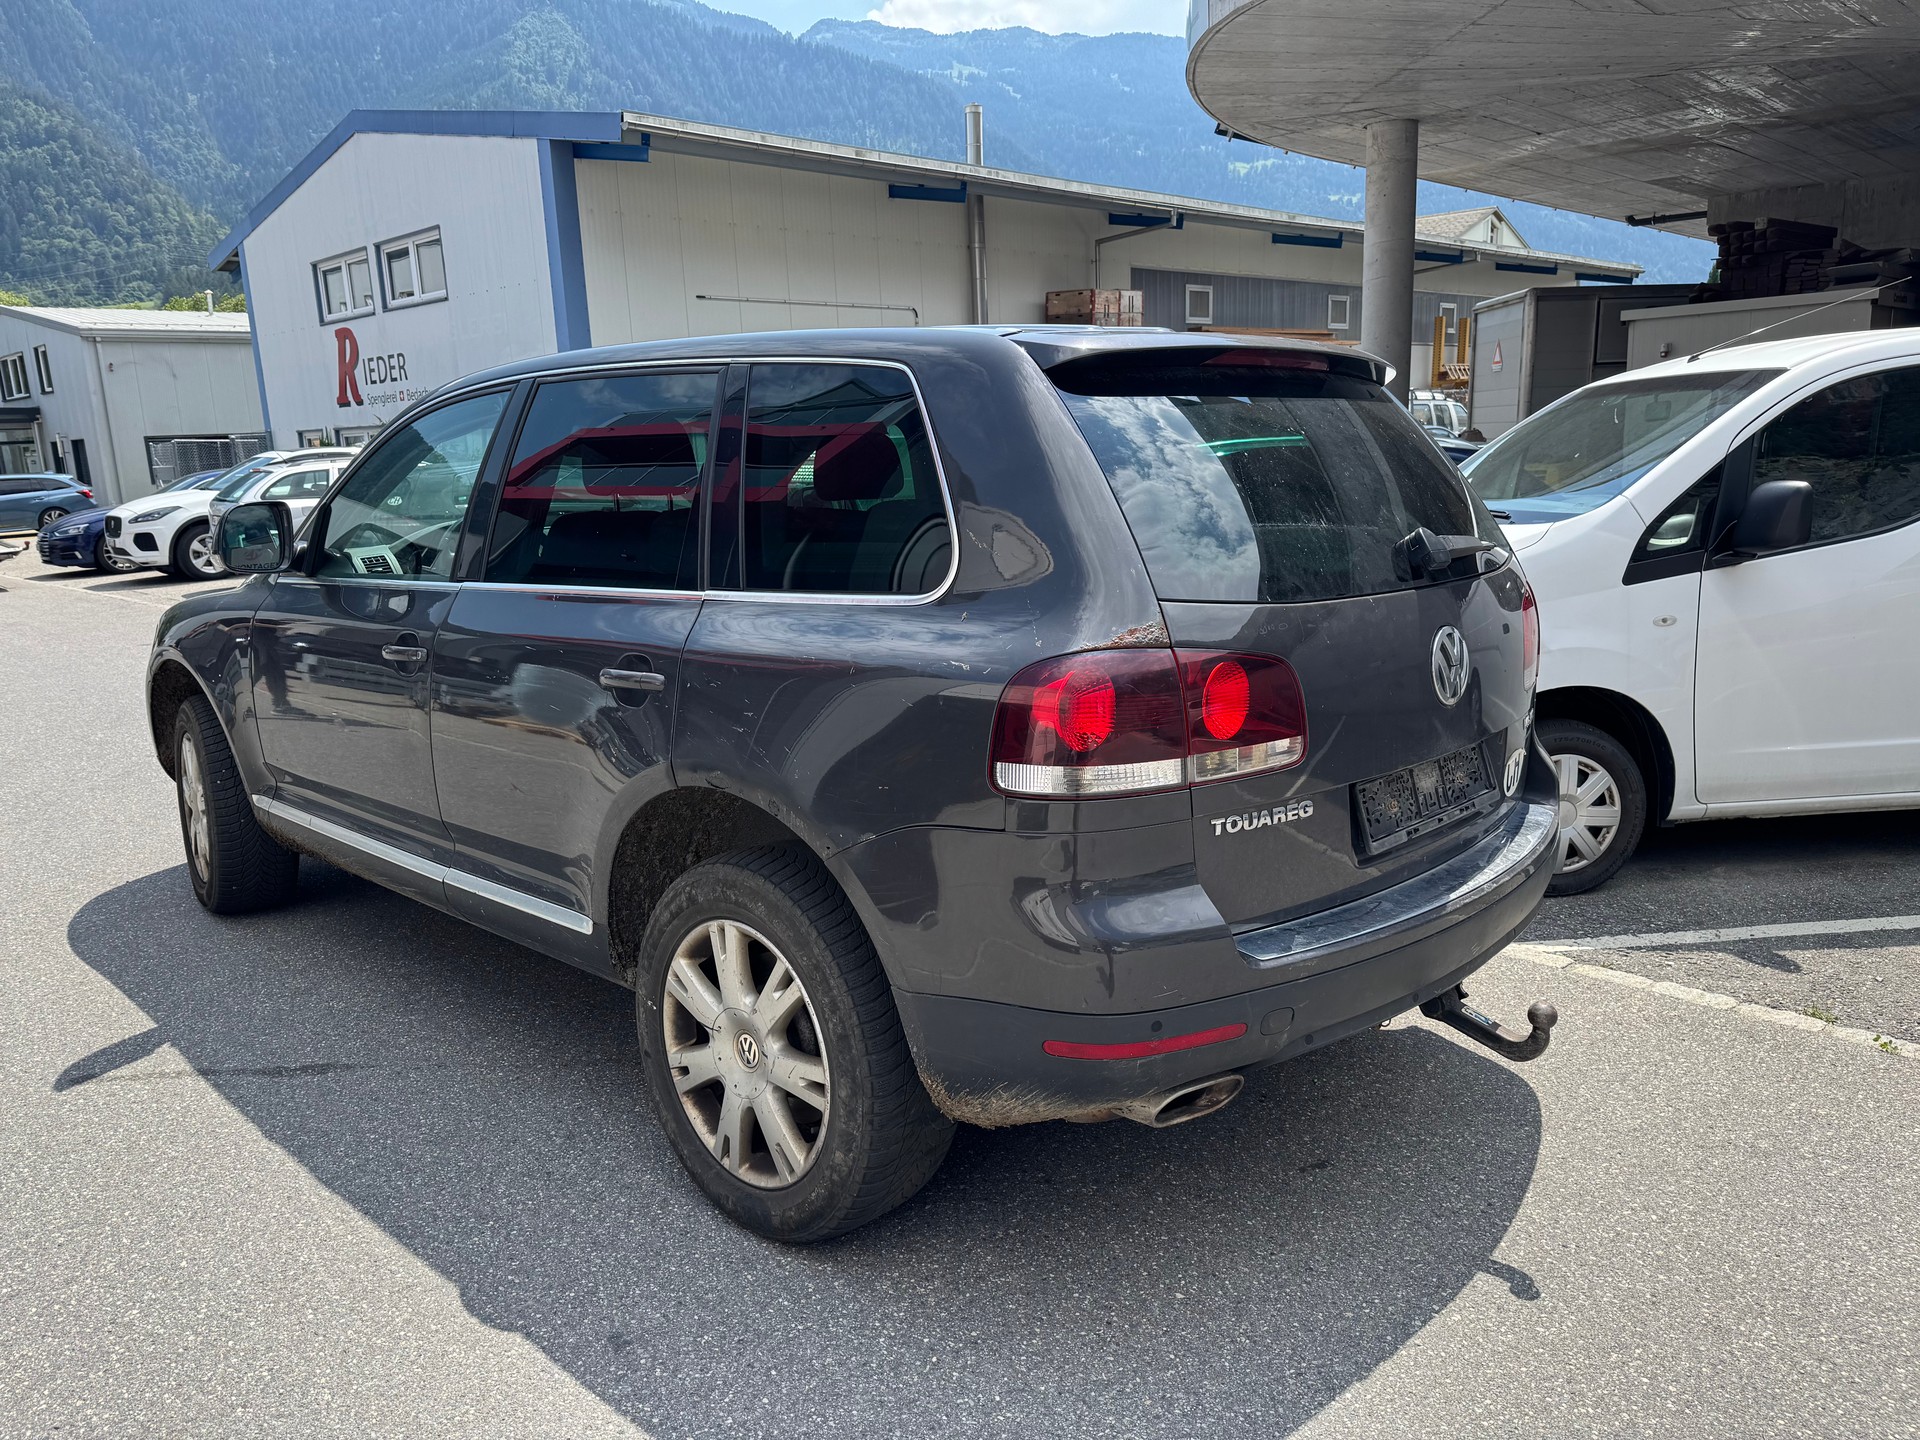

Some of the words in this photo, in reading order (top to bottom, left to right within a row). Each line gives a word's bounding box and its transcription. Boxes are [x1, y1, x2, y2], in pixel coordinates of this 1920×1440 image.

[334, 326, 408, 408] RIEDER
[367, 391, 398, 407] Spenglerei
[1506, 752, 1520, 792] CH
[1210, 800, 1314, 836] TOUAREG
